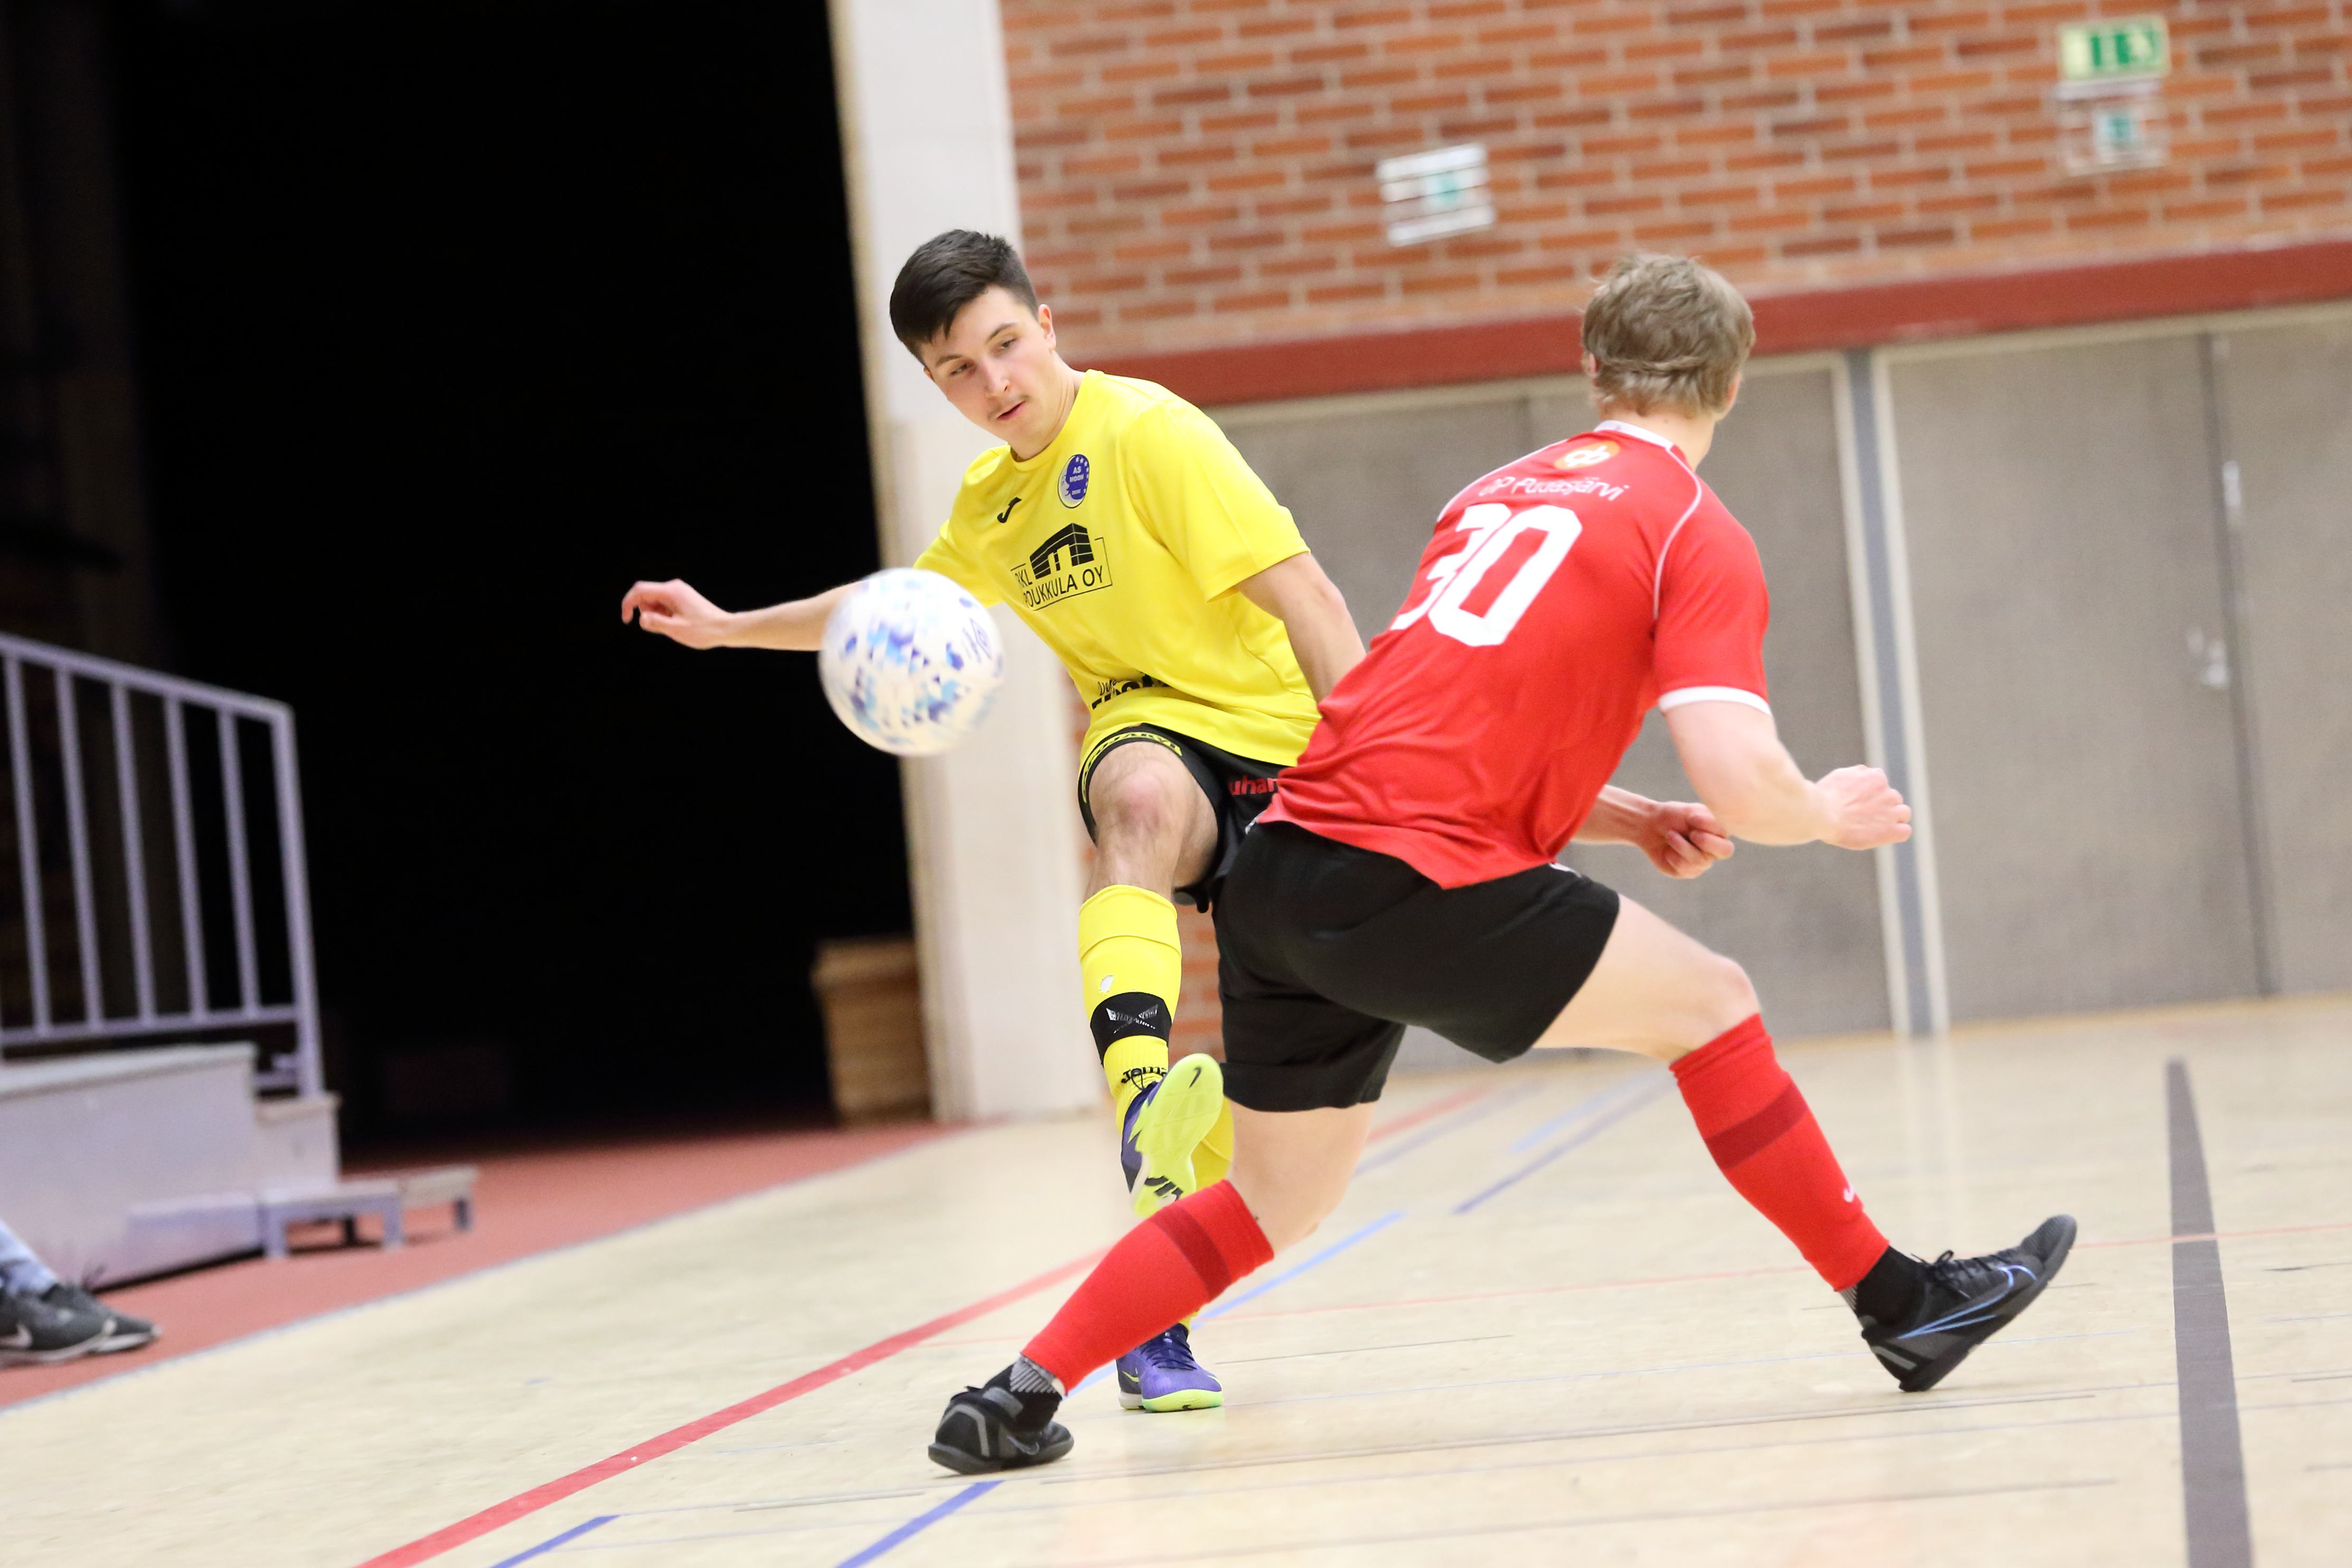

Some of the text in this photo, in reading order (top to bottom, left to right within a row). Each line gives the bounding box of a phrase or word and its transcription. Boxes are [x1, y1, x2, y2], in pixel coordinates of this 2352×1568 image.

[1072, 466, 1081, 474] AS
[1082, 565, 1102, 586] OY
[1390, 503, 1582, 647] 30
